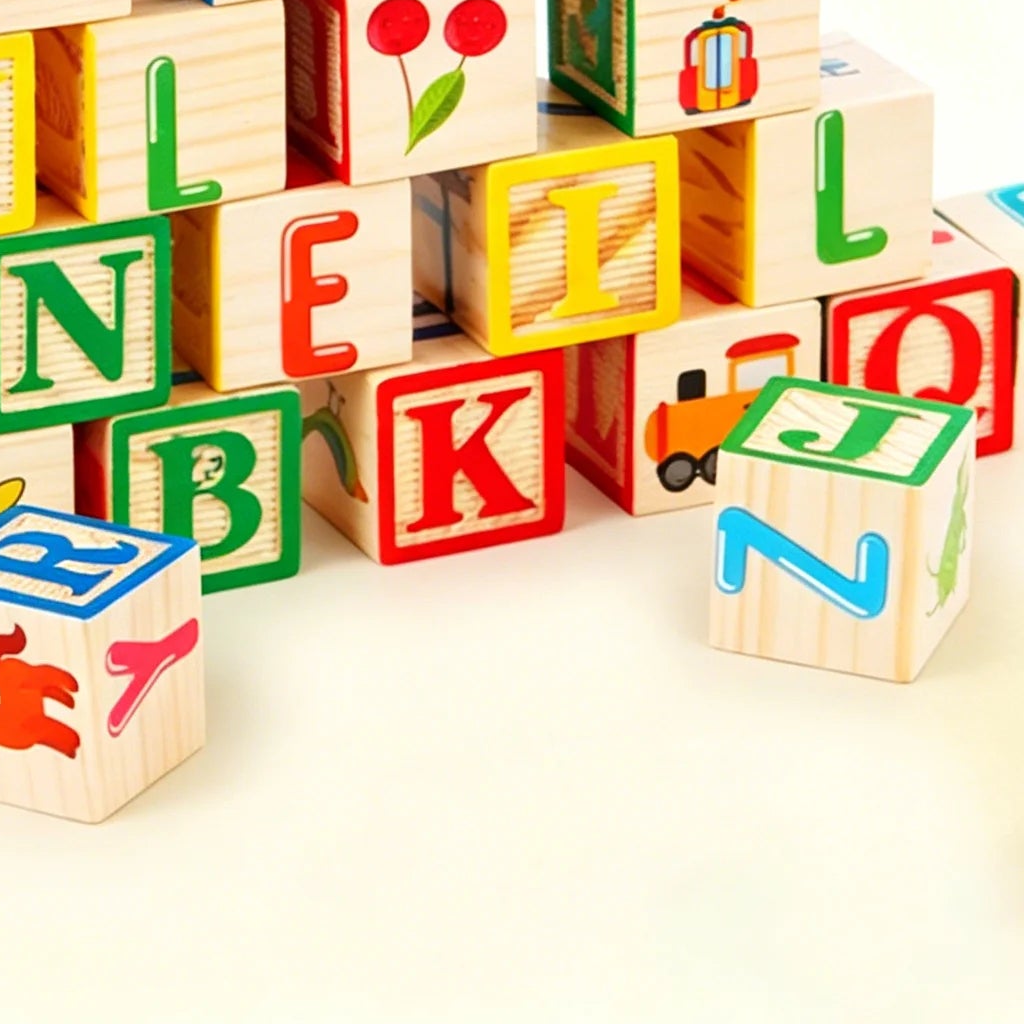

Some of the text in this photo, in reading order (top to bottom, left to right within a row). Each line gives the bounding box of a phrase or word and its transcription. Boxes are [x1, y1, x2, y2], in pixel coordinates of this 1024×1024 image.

[146, 55, 223, 212] L
[815, 109, 888, 265] L
[281, 210, 358, 378] E
[544, 183, 619, 319] I
[3, 250, 143, 394] N
[864, 302, 988, 416] Q
[148, 431, 263, 560] B
[406, 386, 536, 533] K
[778, 401, 926, 460] J
[106, 617, 199, 738] Y
